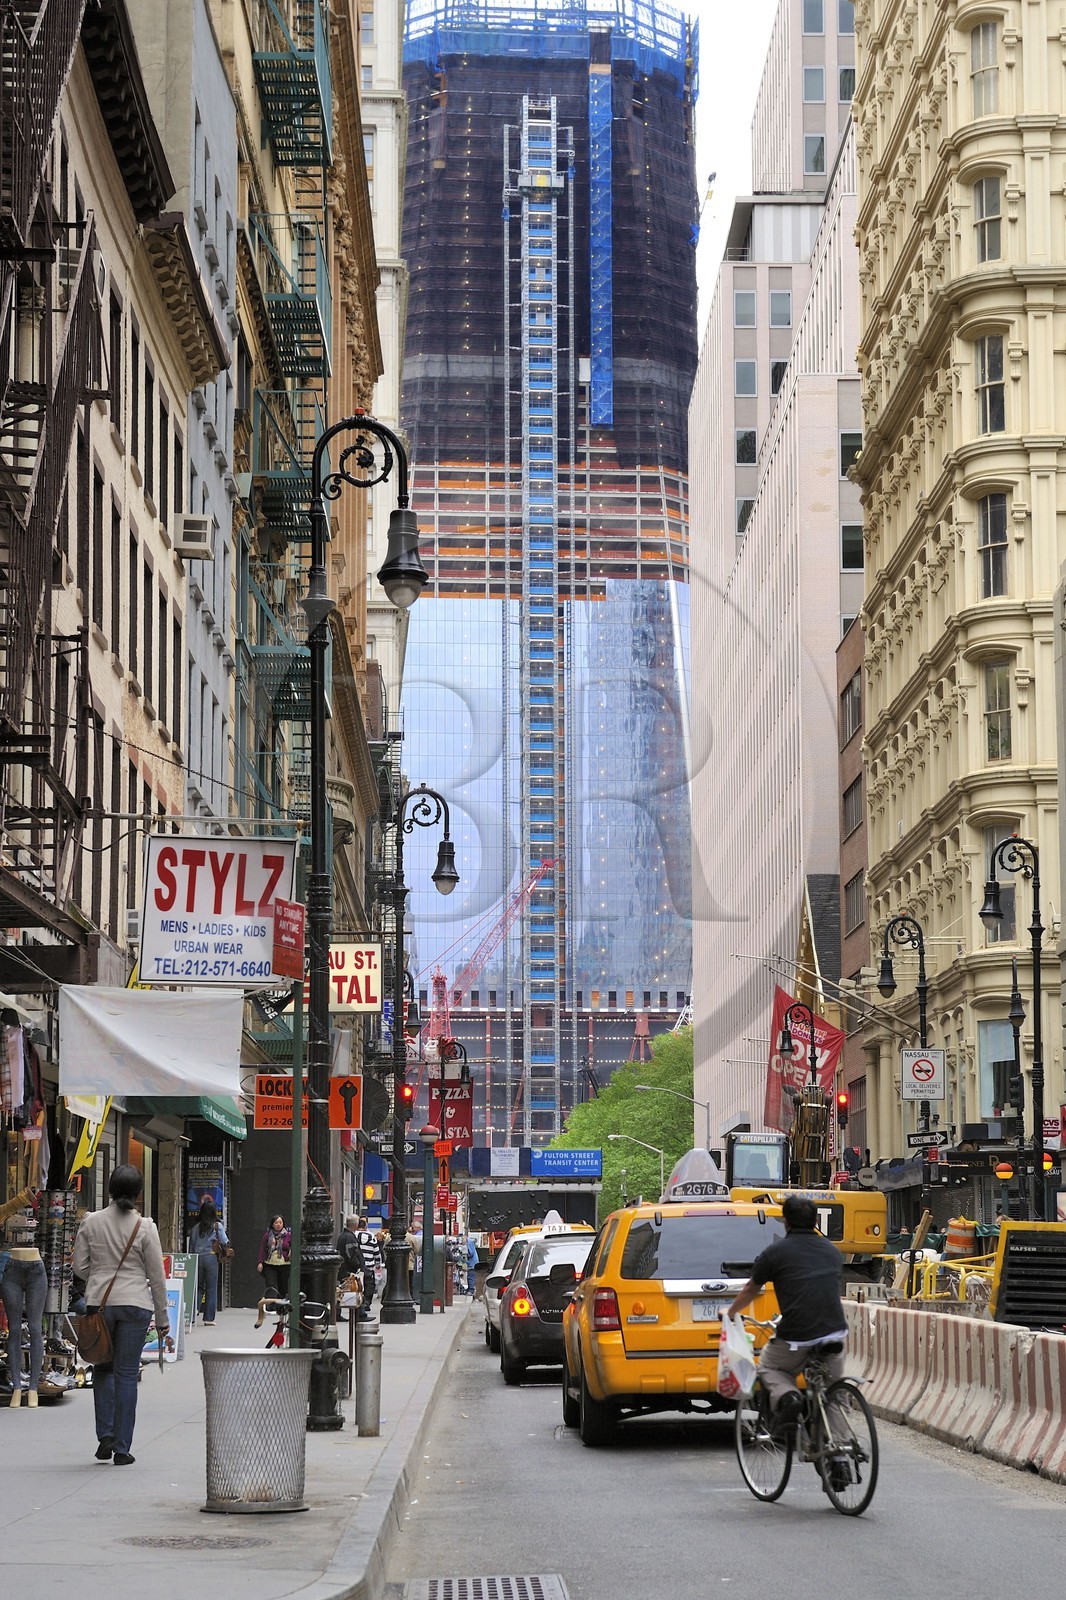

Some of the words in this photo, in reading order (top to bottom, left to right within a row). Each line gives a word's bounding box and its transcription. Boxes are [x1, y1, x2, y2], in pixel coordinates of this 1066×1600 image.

[154, 846, 285, 918] STYLZ
[160, 919, 189, 933] MENS
[198, 922, 234, 936] LADIES
[243, 925, 267, 938] KIDS
[278, 919, 300, 935] ANYTIME
[174, 940, 209, 954] URBAN
[213, 942, 243, 955] WEAR
[354, 950, 378, 970] ST.
[154, 957, 271, 977] TEL:212-571-6640
[431, 1087, 470, 1100] PZZA
[445, 1106, 456, 1119] &
[1044, 1119, 1060, 1127] CVS
[740, 1135, 777, 1144] CATERPILLAR
[929, 1135, 942, 1143] WAY
[188, 1155, 223, 1163] Herniated
[686, 1184, 714, 1195] 2G76
[784, 1190, 836, 1201] SKANSKA
[547, 1225, 567, 1233] TAXI
